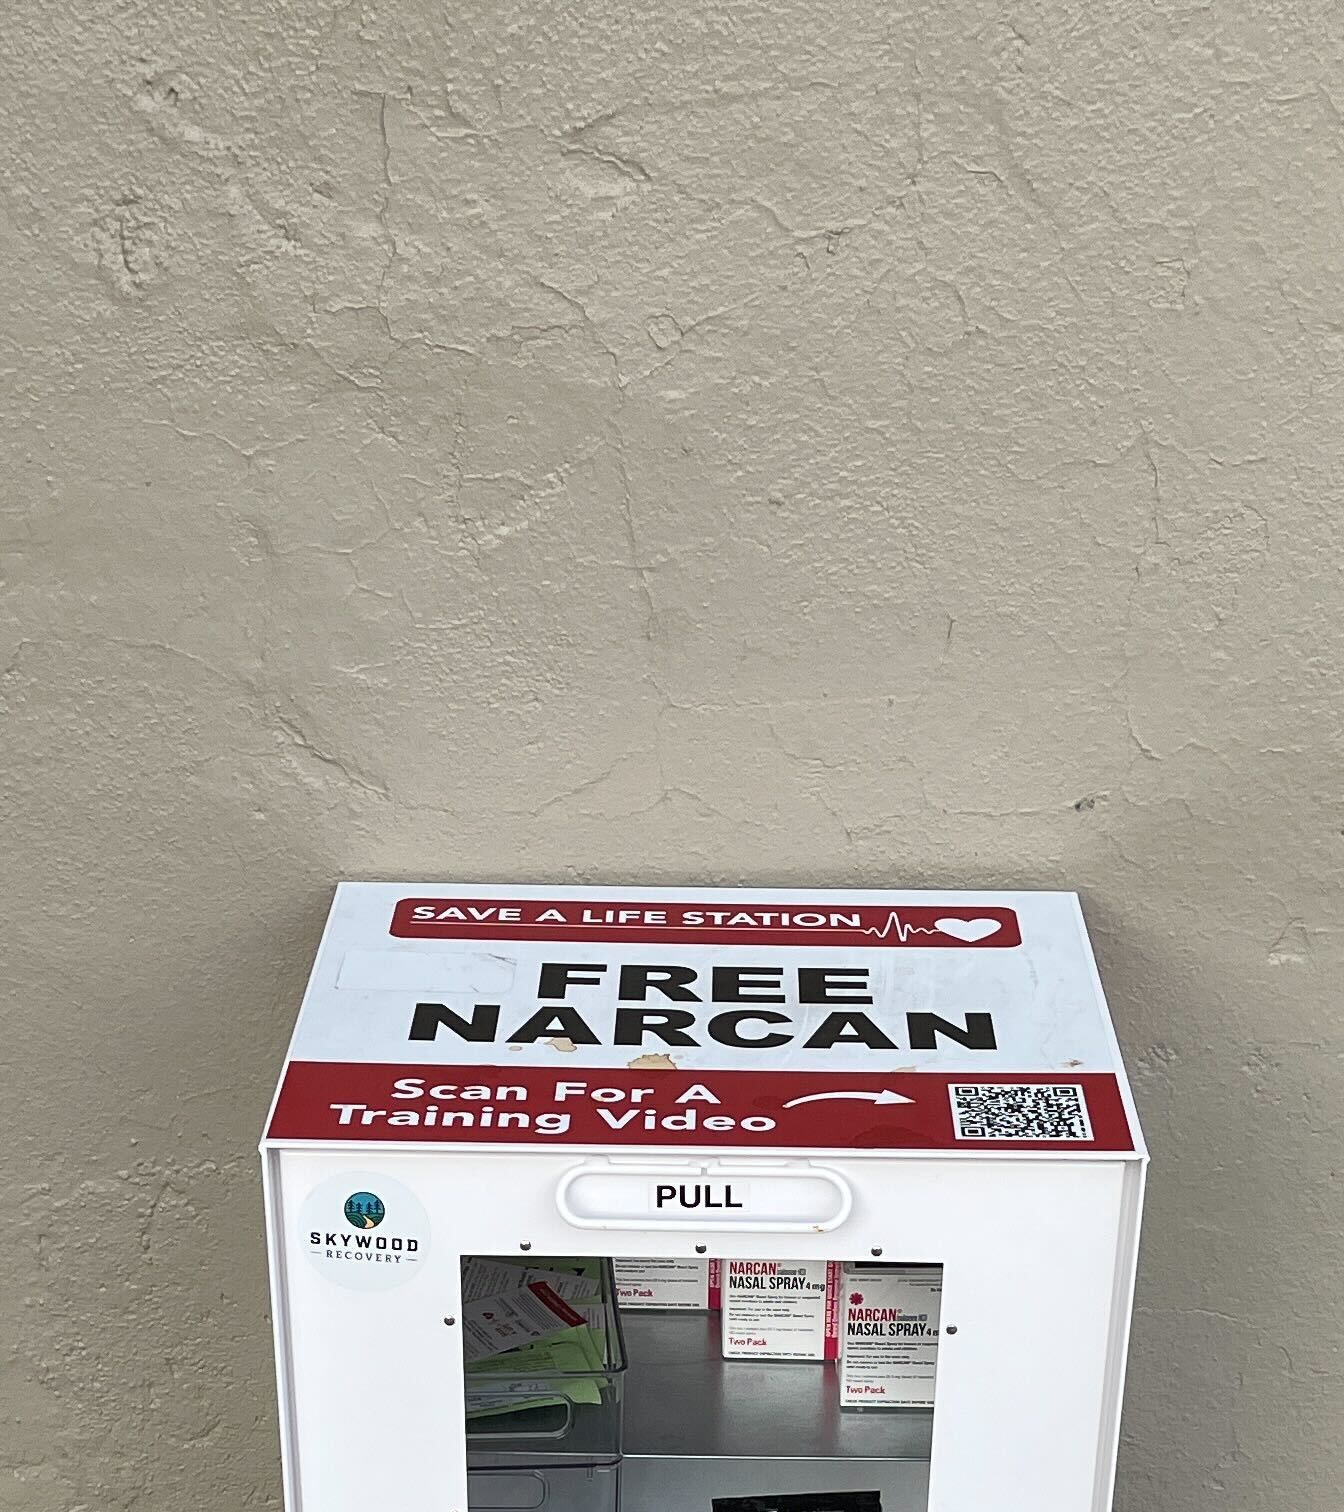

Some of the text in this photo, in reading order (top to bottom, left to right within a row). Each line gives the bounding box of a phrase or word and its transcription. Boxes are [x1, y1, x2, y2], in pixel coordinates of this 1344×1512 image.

[412, 906, 861, 928] SAVE A LIFE STATION
[537, 962, 874, 1005] FREE
[407, 1002, 998, 1051] NARCAN
[390, 1078, 722, 1105] Scan For A
[329, 1103, 777, 1135] Training Video
[656, 1185, 744, 1208] PULL
[310, 1231, 418, 1252] SKYWOOD
[326, 1249, 402, 1263] RECOVERY
[633, 1289, 654, 1297] Pack
[729, 1276, 766, 1289] NASAL
[769, 1277, 806, 1290] SPRAY
[847, 1323, 886, 1336] NASAL
[889, 1323, 927, 1337] SPRAY
[729, 1337, 767, 1346] Two Pack
[846, 1386, 886, 1394] Two Pack
